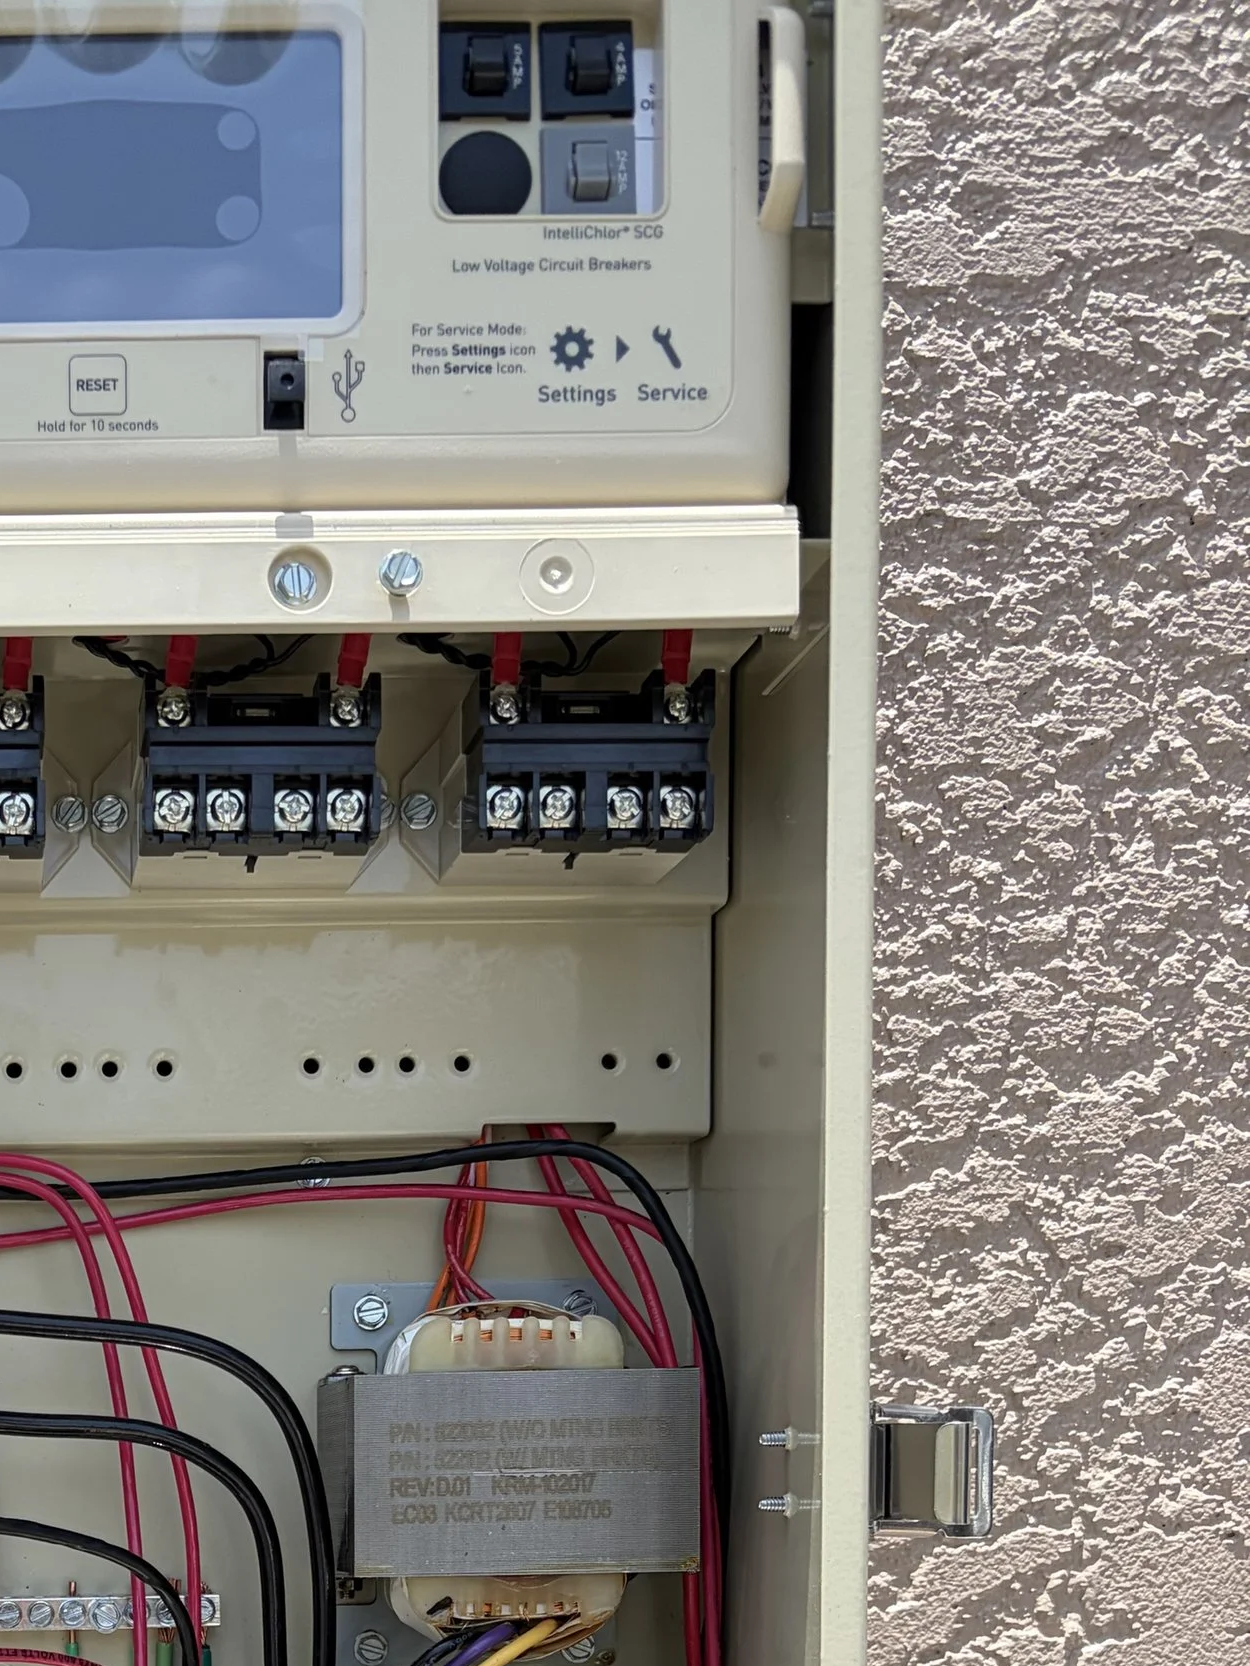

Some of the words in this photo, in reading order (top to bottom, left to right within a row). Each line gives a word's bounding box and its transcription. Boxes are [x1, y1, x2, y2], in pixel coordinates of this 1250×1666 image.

[617, 163, 628, 194] AMP
[634, 225, 664, 239] SCG
[452, 259, 480, 273] Low
[484, 258, 535, 276] Voltage
[539, 258, 584, 272] Circuit
[588, 257, 652, 271] Breakers
[412, 324, 432, 336] For
[437, 324, 484, 336] Service
[488, 323, 526, 336] Mode:
[412, 345, 448, 357] Press
[452, 344, 506, 360] Settings
[509, 344, 536, 356] icon
[412, 363, 440, 375] then
[444, 362, 492, 375] Service
[496, 362, 526, 374] Icon.
[76, 378, 118, 392] RESET
[637, 383, 708, 402] Service
[538, 385, 617, 406] Settings
[37, 420, 66, 432] Hold
[69, 420, 86, 432] for
[92, 420, 105, 431] 10
[108, 419, 159, 432] seconds
